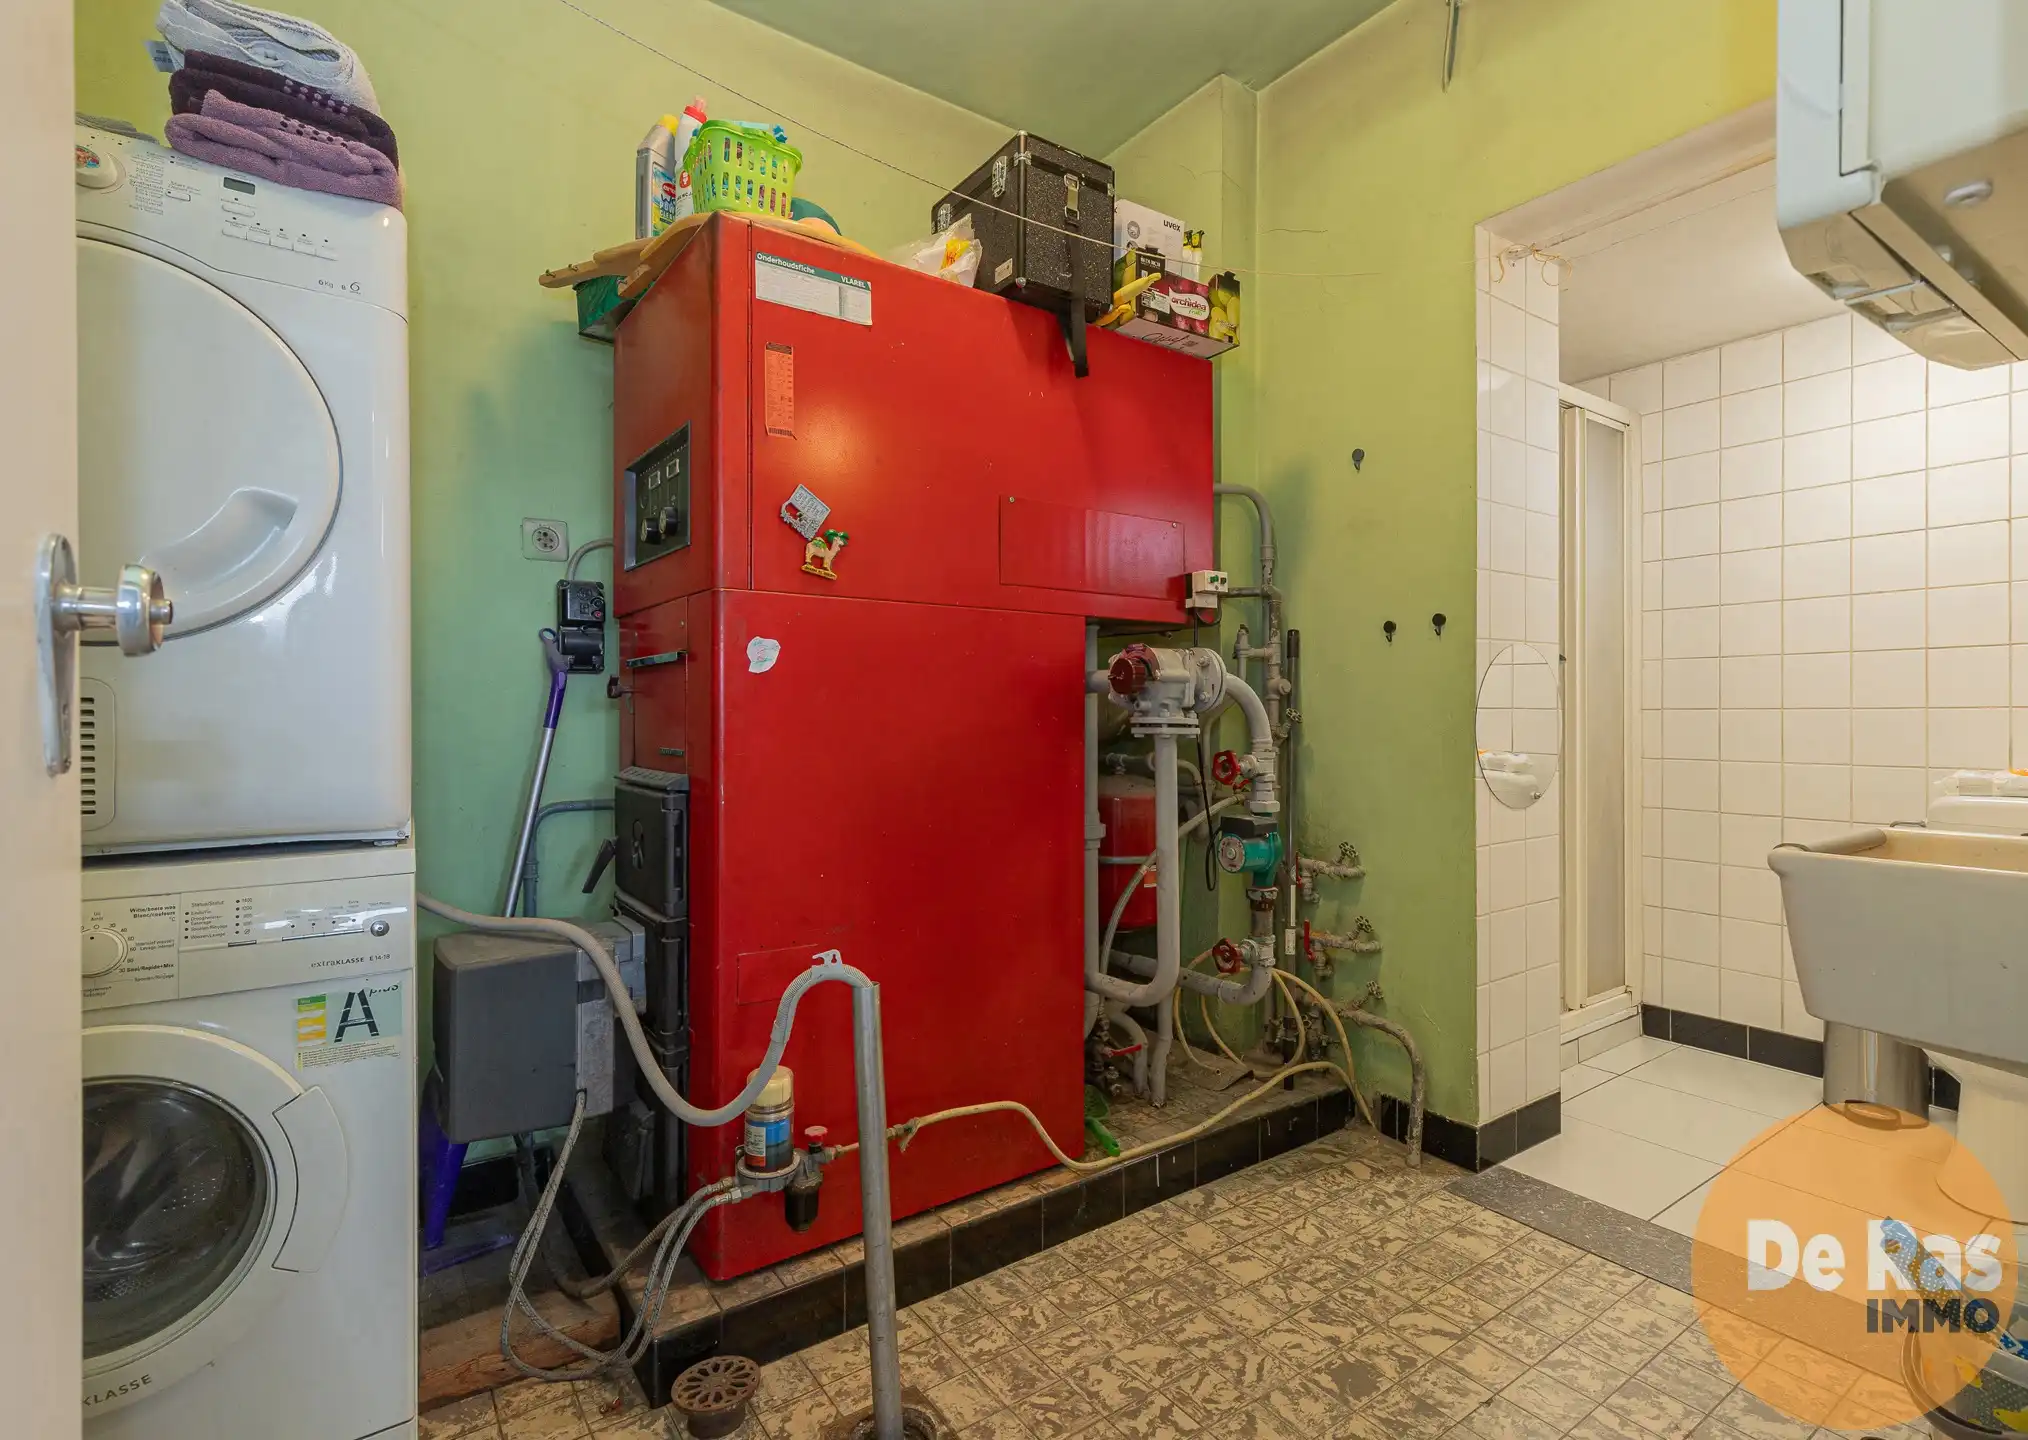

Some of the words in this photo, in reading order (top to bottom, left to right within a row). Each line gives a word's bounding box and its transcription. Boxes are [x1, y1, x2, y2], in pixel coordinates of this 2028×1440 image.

[1163, 219, 1181, 232] uvex
[756, 252, 816, 274] Onderhoudsfiche
[840, 275, 866, 288] VLAREL
[1171, 295, 1207, 311] orchidea
[310, 956, 365, 968] extraKLASSE
